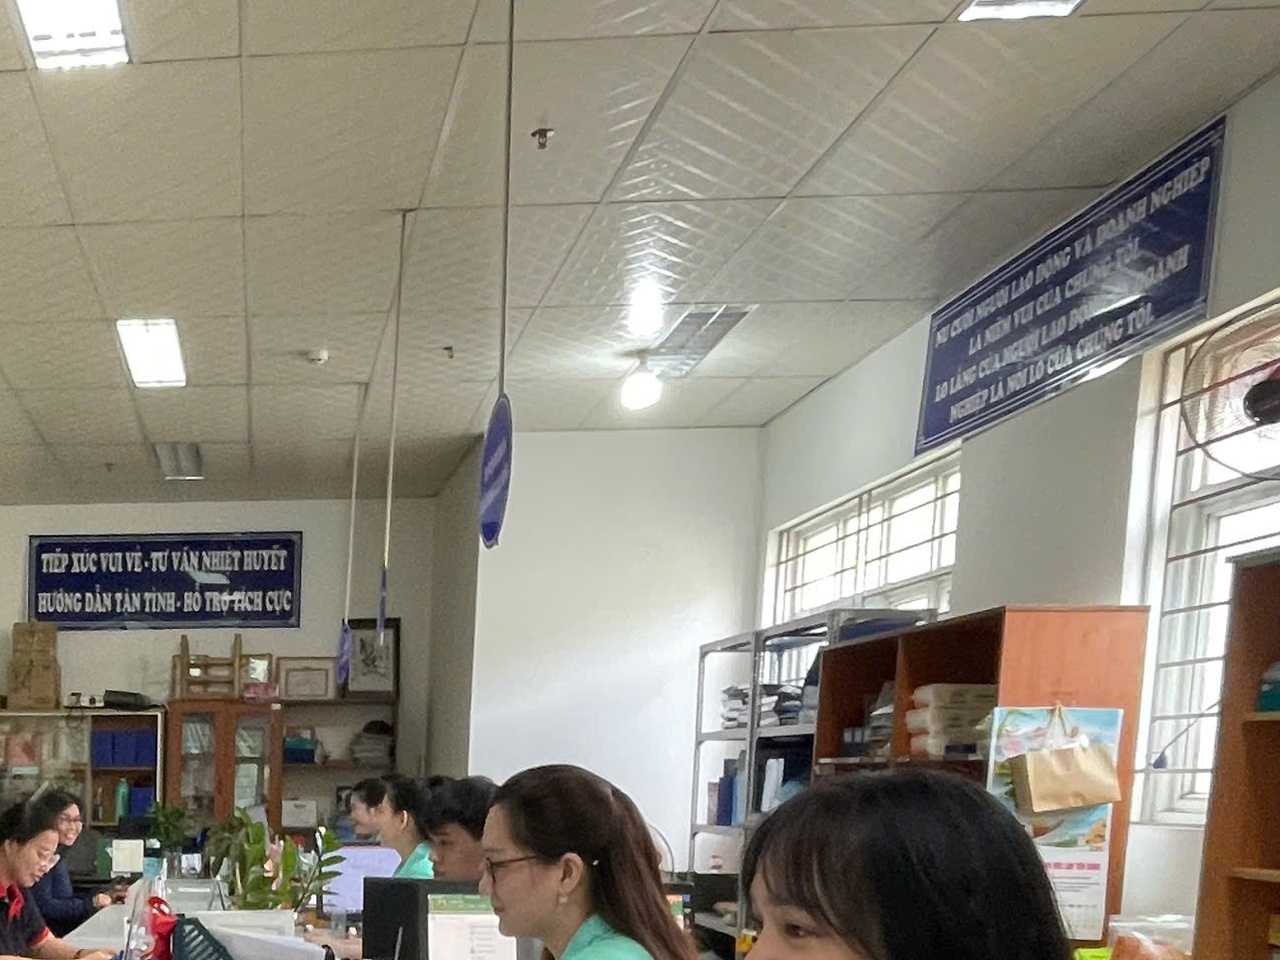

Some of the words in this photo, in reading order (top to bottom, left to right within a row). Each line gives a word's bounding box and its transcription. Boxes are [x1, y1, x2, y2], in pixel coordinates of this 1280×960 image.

[1011, 270, 1033, 299] LAO
[1150, 155, 1210, 211] NGHIỆP
[1012, 300, 1033, 329] VUI
[1041, 314, 1066, 344] LAO
[1028, 358, 1044, 383] LO
[41, 548, 69, 573] TIẾP
[71, 549, 97, 573] XÚC
[100, 551, 123, 573] VUI
[172, 546, 200, 572] VẤN
[202, 546, 242, 574] NHIỆT
[244, 545, 287, 571] HUYẾT
[38, 588, 82, 613] HƯỚNG
[85, 584, 112, 613] DẪN
[115, 588, 141, 616] TẬN
[144, 586, 175, 613] TÌNH
[266, 589, 292, 615] CỰC
